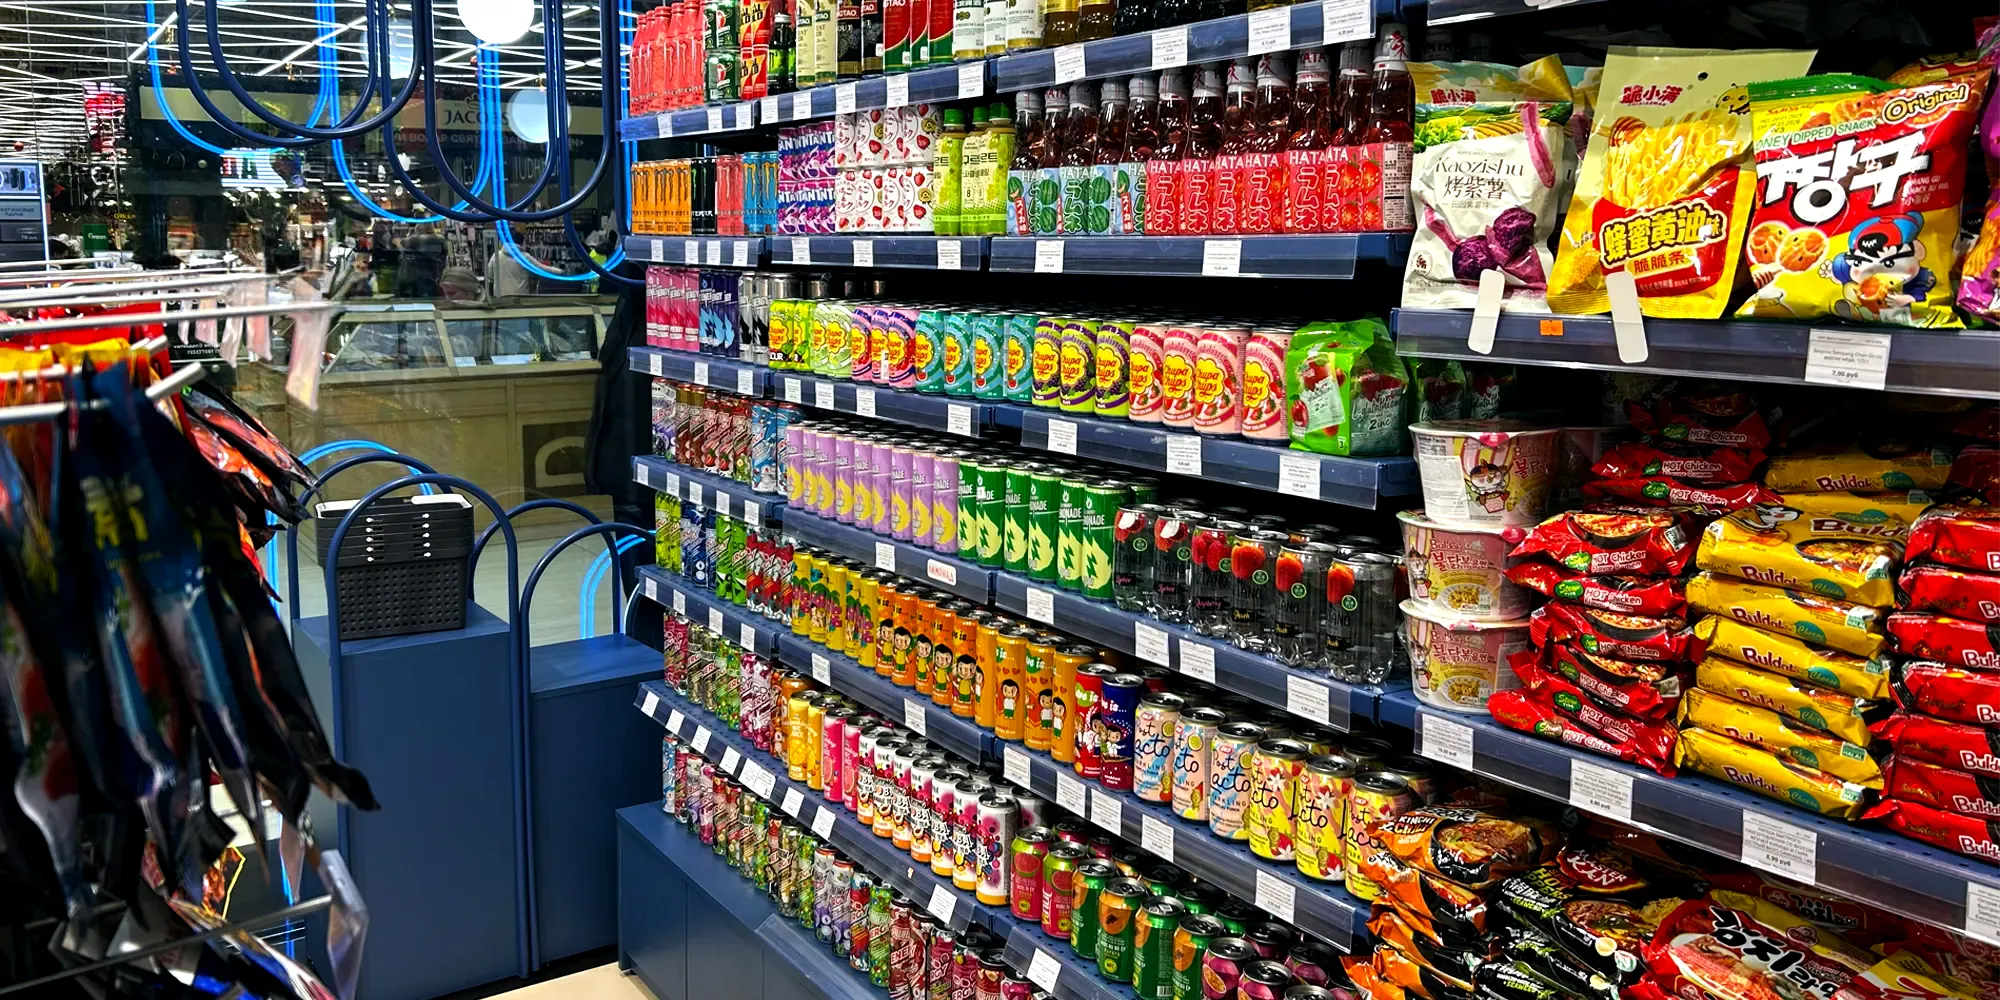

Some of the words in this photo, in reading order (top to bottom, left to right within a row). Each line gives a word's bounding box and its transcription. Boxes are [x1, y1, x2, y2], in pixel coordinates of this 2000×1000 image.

[1430, 88, 1477, 104] 脆小满
[1620, 85, 1683, 105] 脆小满
[1883, 84, 1969, 122] Original
[1755, 133, 1791, 150] ONEY
[1792, 125, 1833, 145] DIPPED
[1837, 117, 1876, 136] SNACK
[1128, 163, 1147, 176] HA
[1245, 154, 1279, 167] HATA
[1435, 157, 1524, 177] Kaozishu
[1756, 129, 1930, 224] 짱구
[1443, 175, 1507, 200] 烤紫薯
[1909, 184, 1928, 194] NACK
[1153, 175, 1175, 233] ラムネ
[1187, 174, 1209, 233] ラムネ
[1216, 171, 1236, 232] ラムネ
[1248, 169, 1271, 232] ラムネ
[1294, 166, 1320, 231] ラムネ
[1603, 204, 1722, 262] 蜂蜜黄油味
[1633, 250, 1685, 274] 脆脆条
[1131, 363, 1149, 372] hupa
[1131, 374, 1148, 388] hups
[1244, 373, 1265, 383] hupa
[1244, 384, 1263, 400] hups
[1690, 428, 1710, 439] HOT
[1710, 430, 1747, 442] Chicken
[1662, 460, 1683, 470] HOT
[1684, 460, 1722, 472] Chicken
[1816, 473, 1873, 492] Buldak
[1670, 488, 1690, 500] HOT
[1690, 491, 1728, 506] Chicken
[1592, 553, 1609, 564] HOT
[1610, 550, 1646, 563] Chicken
[1584, 587, 1608, 600] HOT
[1608, 591, 1643, 606] Chicken
[1731, 606, 1786, 630] Buldak
[1621, 644, 1660, 658] Chicken
[1741, 645, 1798, 673] Buldak
[1579, 672, 1597, 687] HOT
[1597, 683, 1630, 704] Chicken
[1582, 705, 1602, 721] HOT
[1139, 722, 1156, 737] ost
[1134, 733, 1170, 759] acto
[1562, 729, 1584, 744] HOT
[1584, 736, 1622, 756] Chicken
[1722, 765, 1778, 794] Buldak
[1567, 855, 1615, 887] KAN
